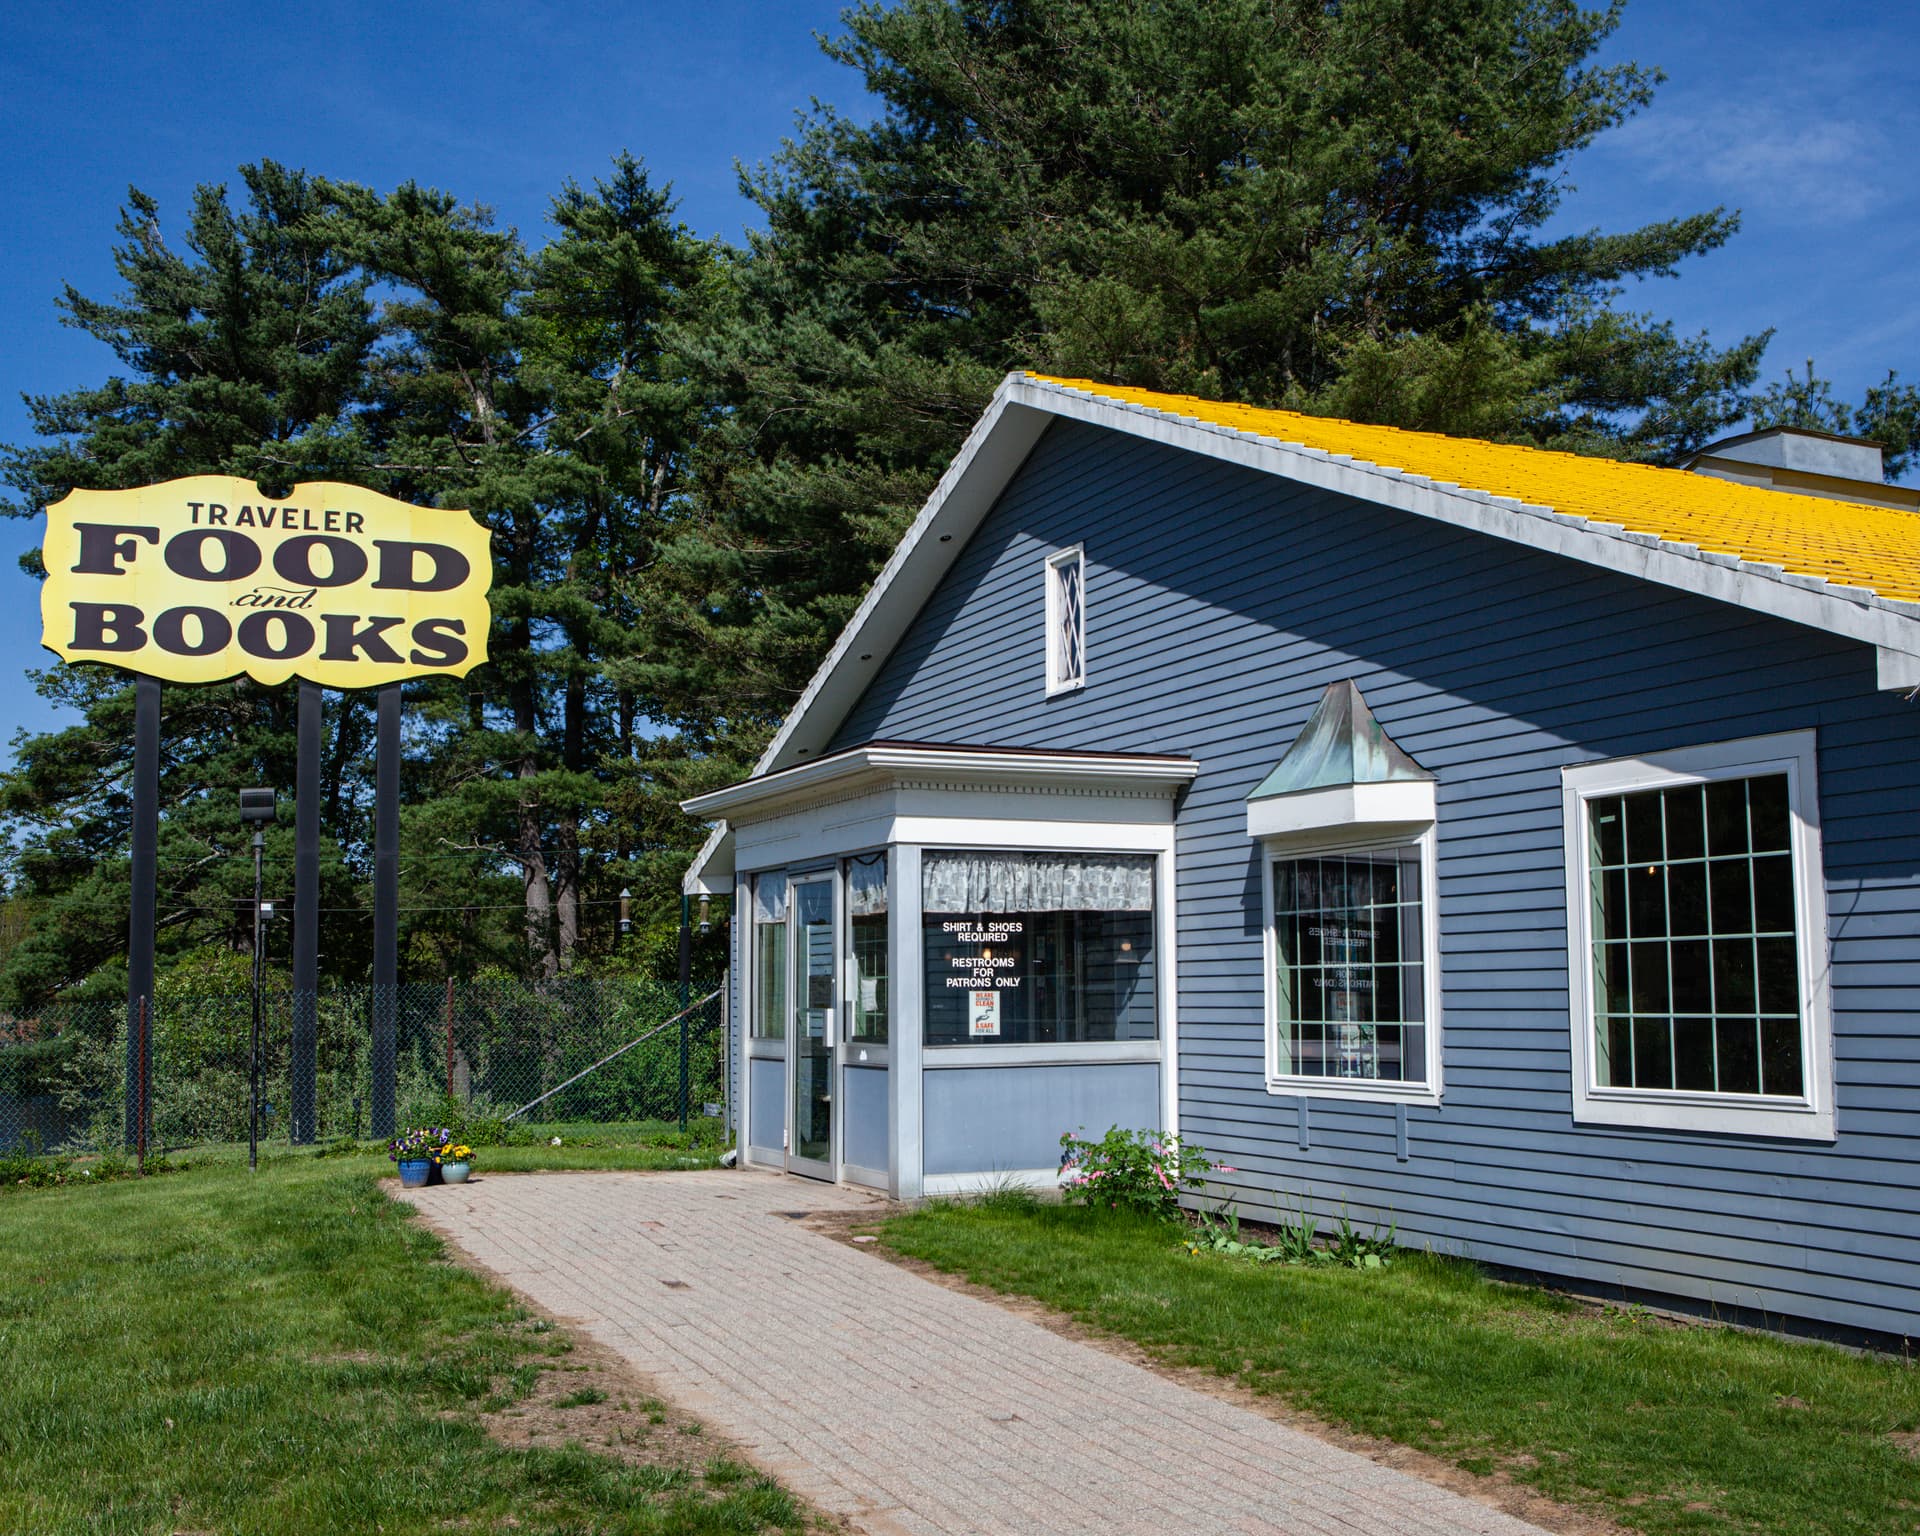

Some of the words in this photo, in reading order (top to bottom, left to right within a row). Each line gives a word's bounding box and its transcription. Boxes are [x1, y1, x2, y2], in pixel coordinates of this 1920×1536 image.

[187, 502, 365, 534] TRAVELER
[71, 522, 470, 592] FOOD
[229, 586, 318, 610] and
[67, 601, 469, 667] BOOKS
[942, 922, 972, 932] SHIRT
[976, 922, 984, 932] &
[988, 922, 1023, 932] SHOES
[957, 932, 1008, 942] REQUIRED
[952, 958, 1015, 968] RESTROOMS
[973, 968, 994, 977] FOR
[946, 978, 991, 988] PATRONS
[995, 977, 1020, 987] ONLY
